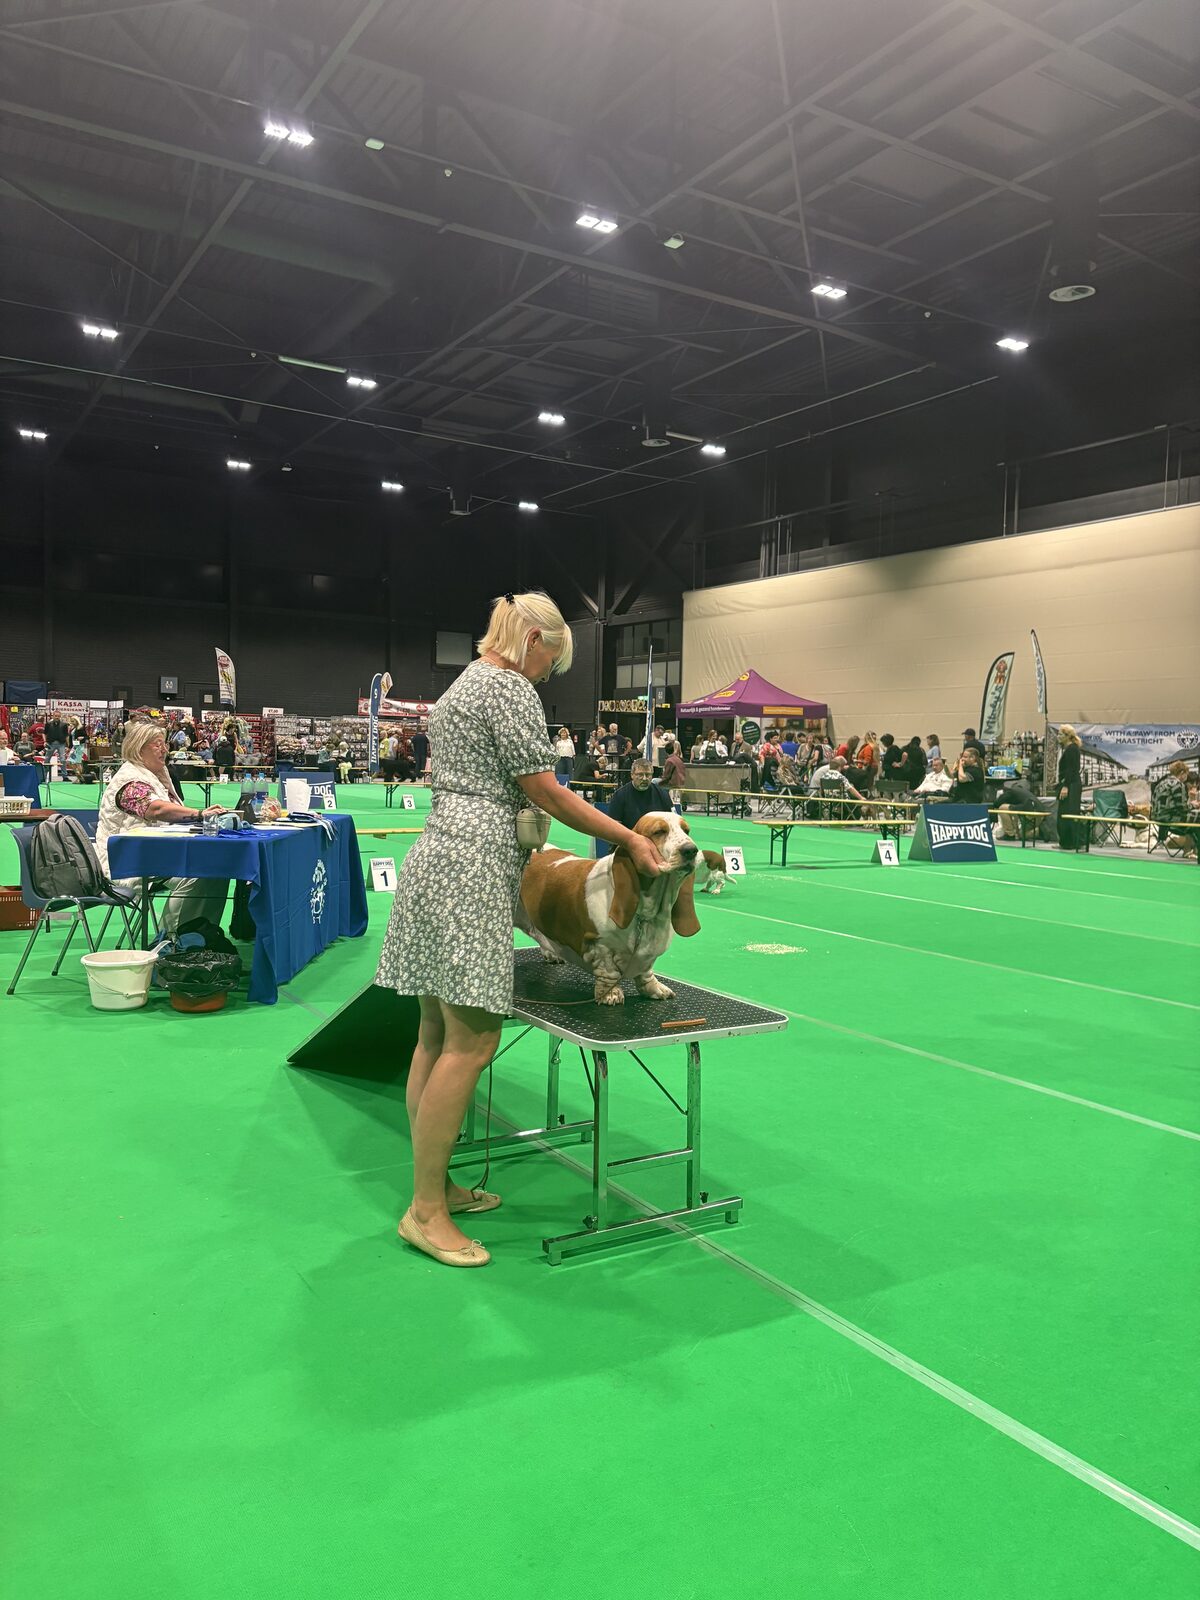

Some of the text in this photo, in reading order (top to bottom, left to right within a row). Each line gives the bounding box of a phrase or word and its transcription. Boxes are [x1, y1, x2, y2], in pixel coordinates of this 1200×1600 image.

[314, 785, 332, 796] DOG
[327, 800, 333, 808] 2
[406, 799, 413, 808] 3
[930, 823, 989, 843] HAPPY DOG
[884, 849, 892, 862] 4
[731, 857, 740, 871] 3
[380, 870, 388, 887] 1
